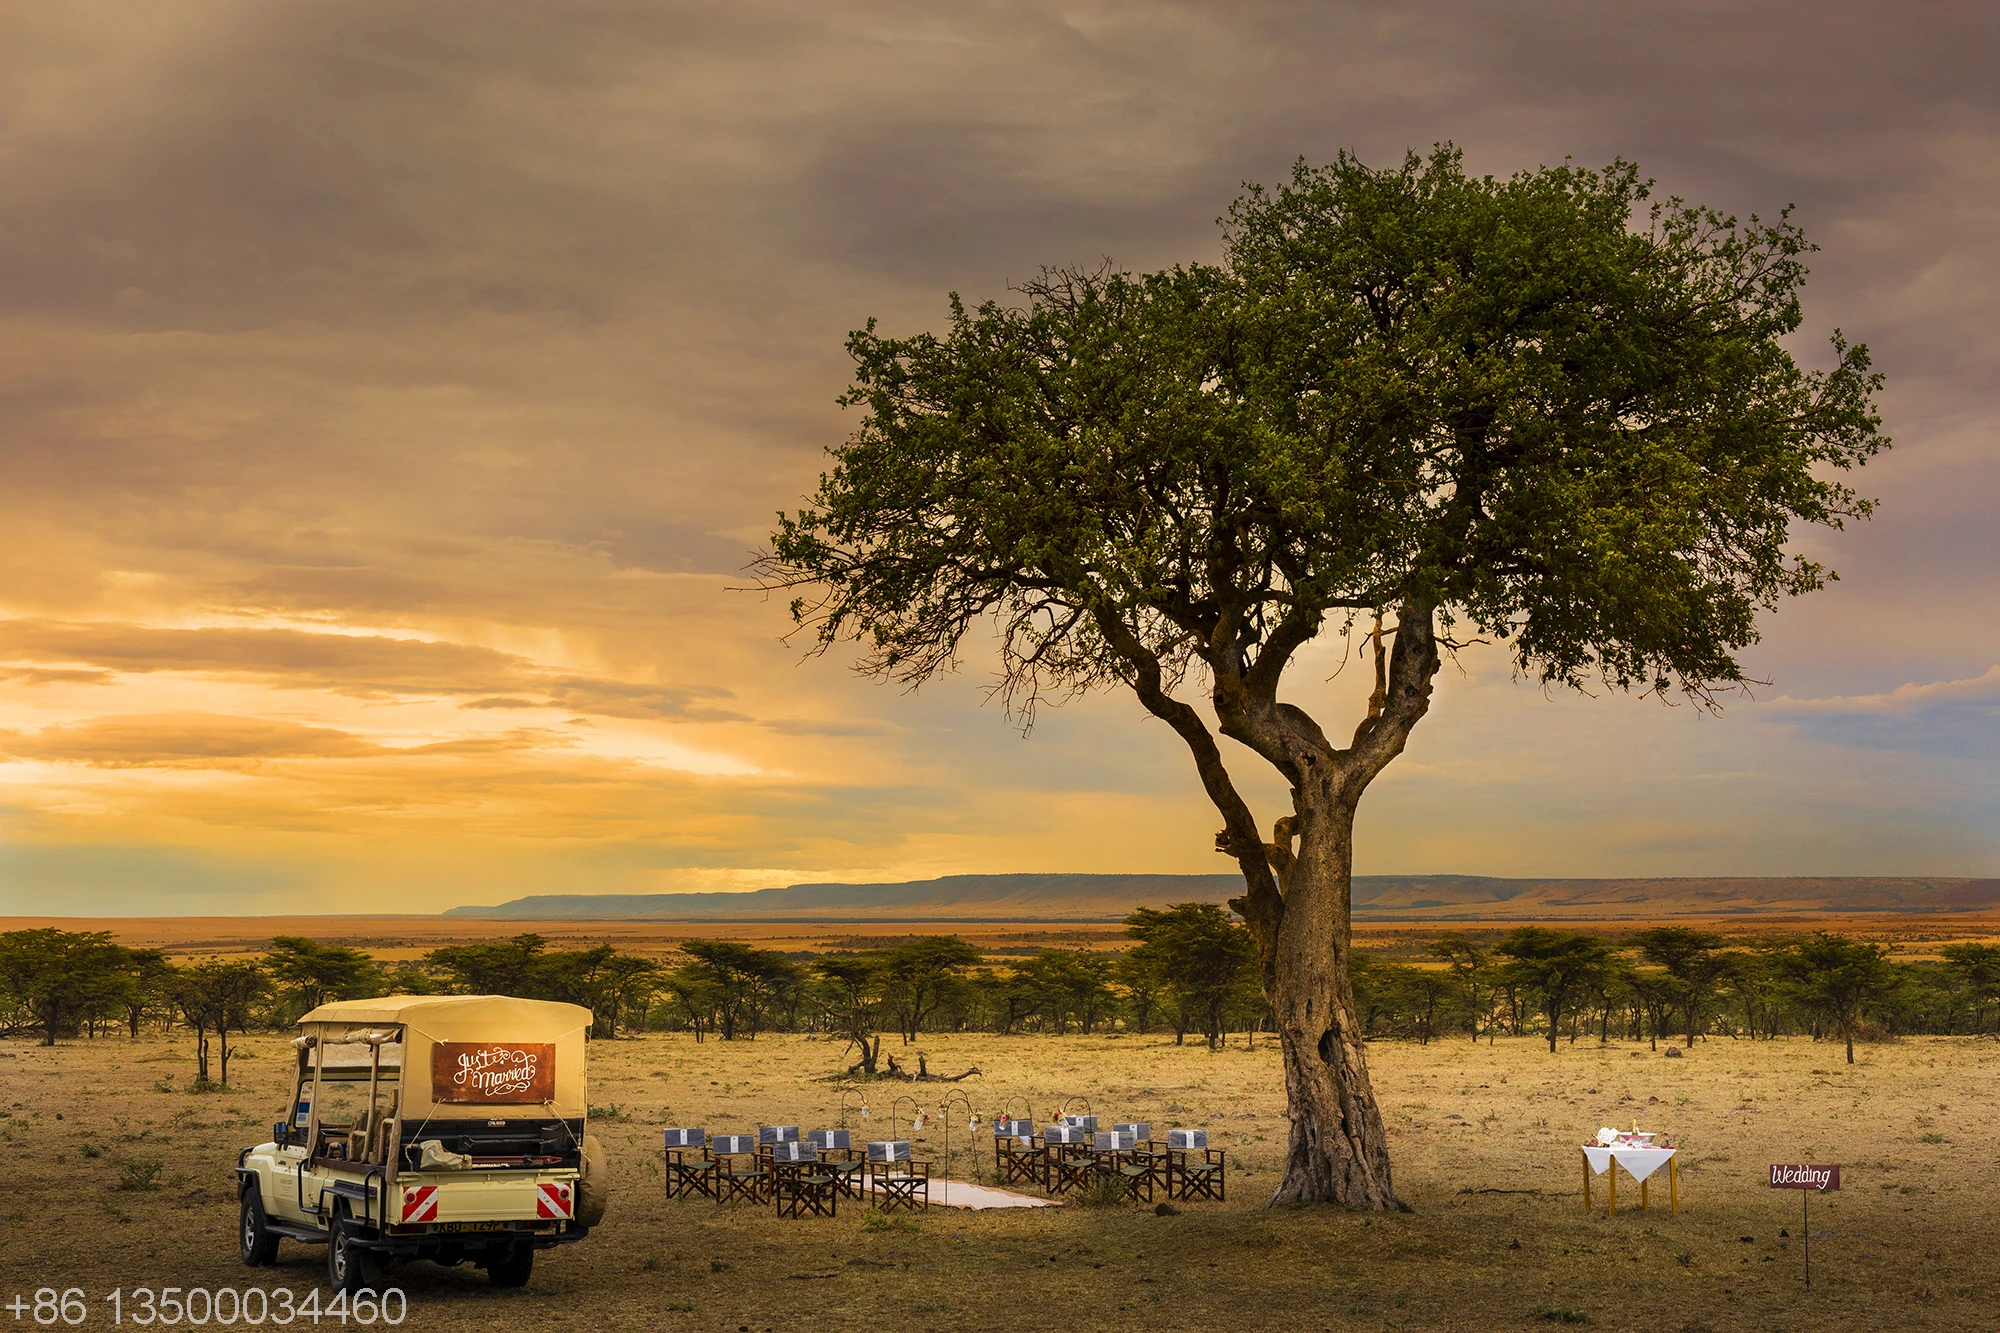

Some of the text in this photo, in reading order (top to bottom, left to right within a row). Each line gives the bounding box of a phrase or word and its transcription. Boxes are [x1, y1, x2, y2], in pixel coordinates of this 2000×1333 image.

[454, 1048, 506, 1084] Just
[472, 1051, 536, 1093] Married
[1772, 1165, 1831, 1189] Wedding
